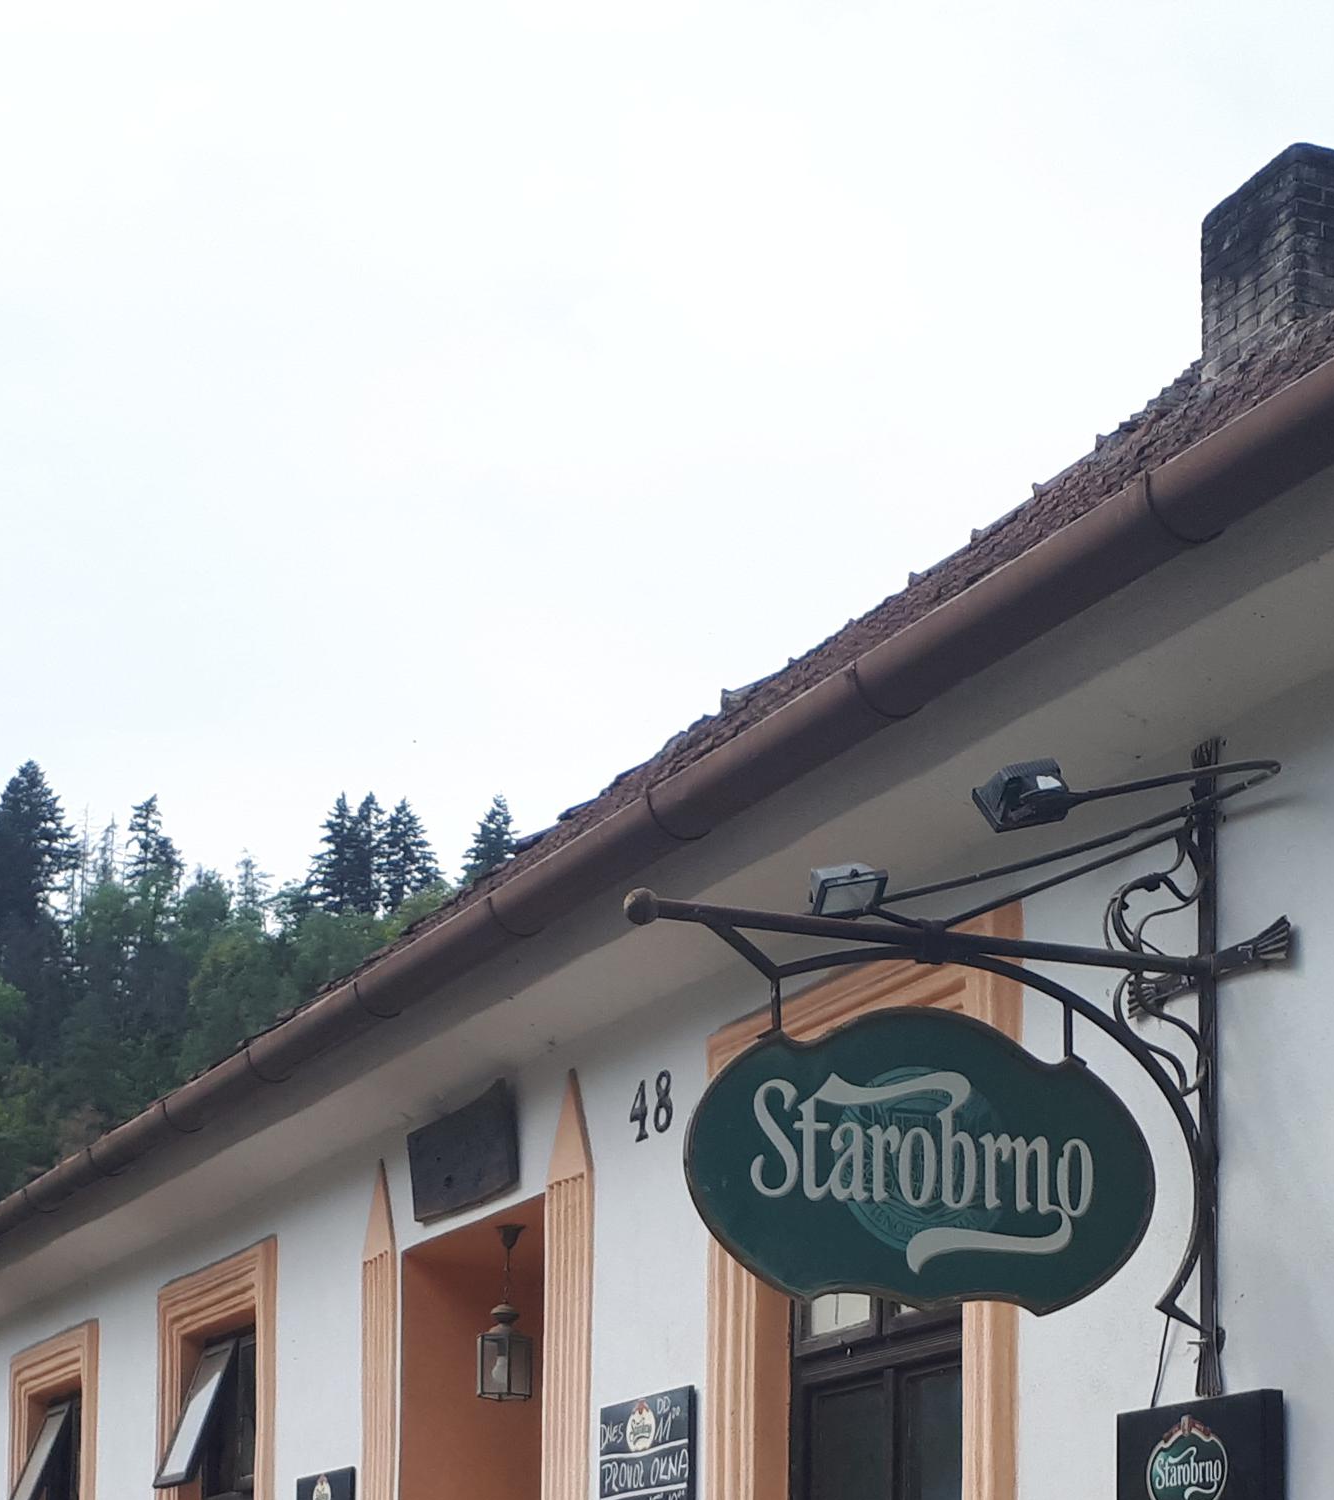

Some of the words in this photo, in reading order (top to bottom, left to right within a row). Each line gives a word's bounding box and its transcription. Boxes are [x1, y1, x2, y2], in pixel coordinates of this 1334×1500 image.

[627, 1068, 674, 1143] 48
[750, 1071, 1094, 1276] Starobrno
[601, 1461, 645, 1493] PROVOZ
[650, 1448, 689, 1485] OKNA
[1155, 1446, 1222, 1500] Starobrno
